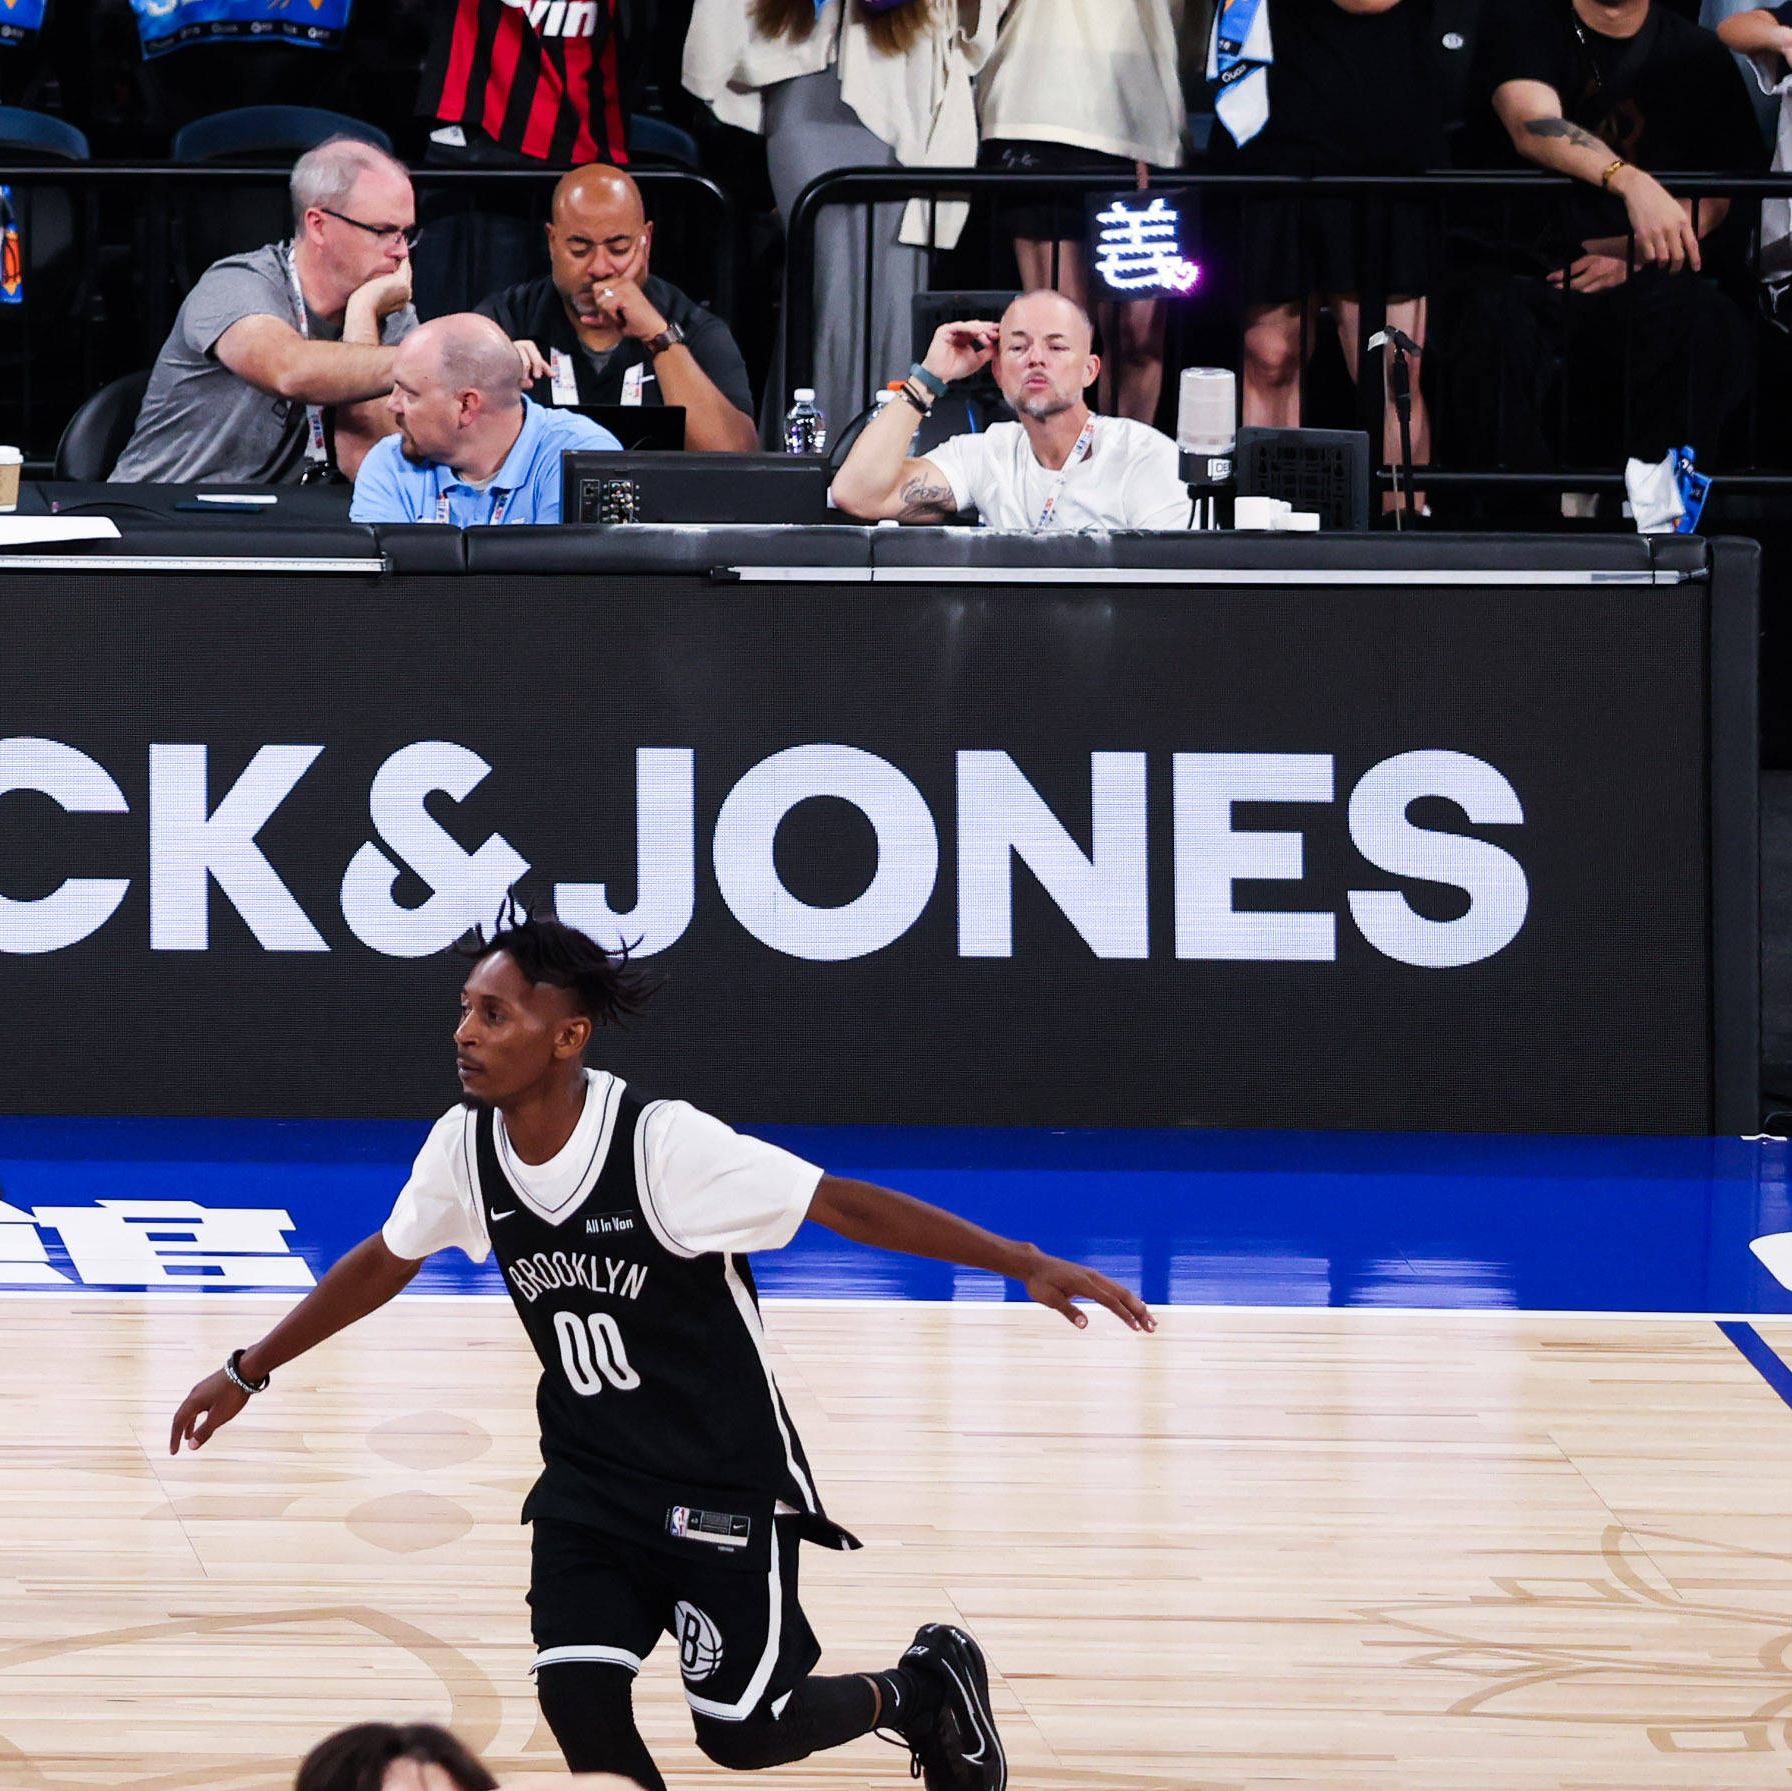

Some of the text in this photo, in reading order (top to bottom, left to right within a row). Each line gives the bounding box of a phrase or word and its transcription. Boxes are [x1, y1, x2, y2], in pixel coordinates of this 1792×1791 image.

[585, 1218, 600, 1235] All
[601, 1218, 613, 1233] In
[508, 1250, 648, 1303] BROOKLYN
[553, 1310, 642, 1397] 00
[680, 1610, 701, 1669] B
